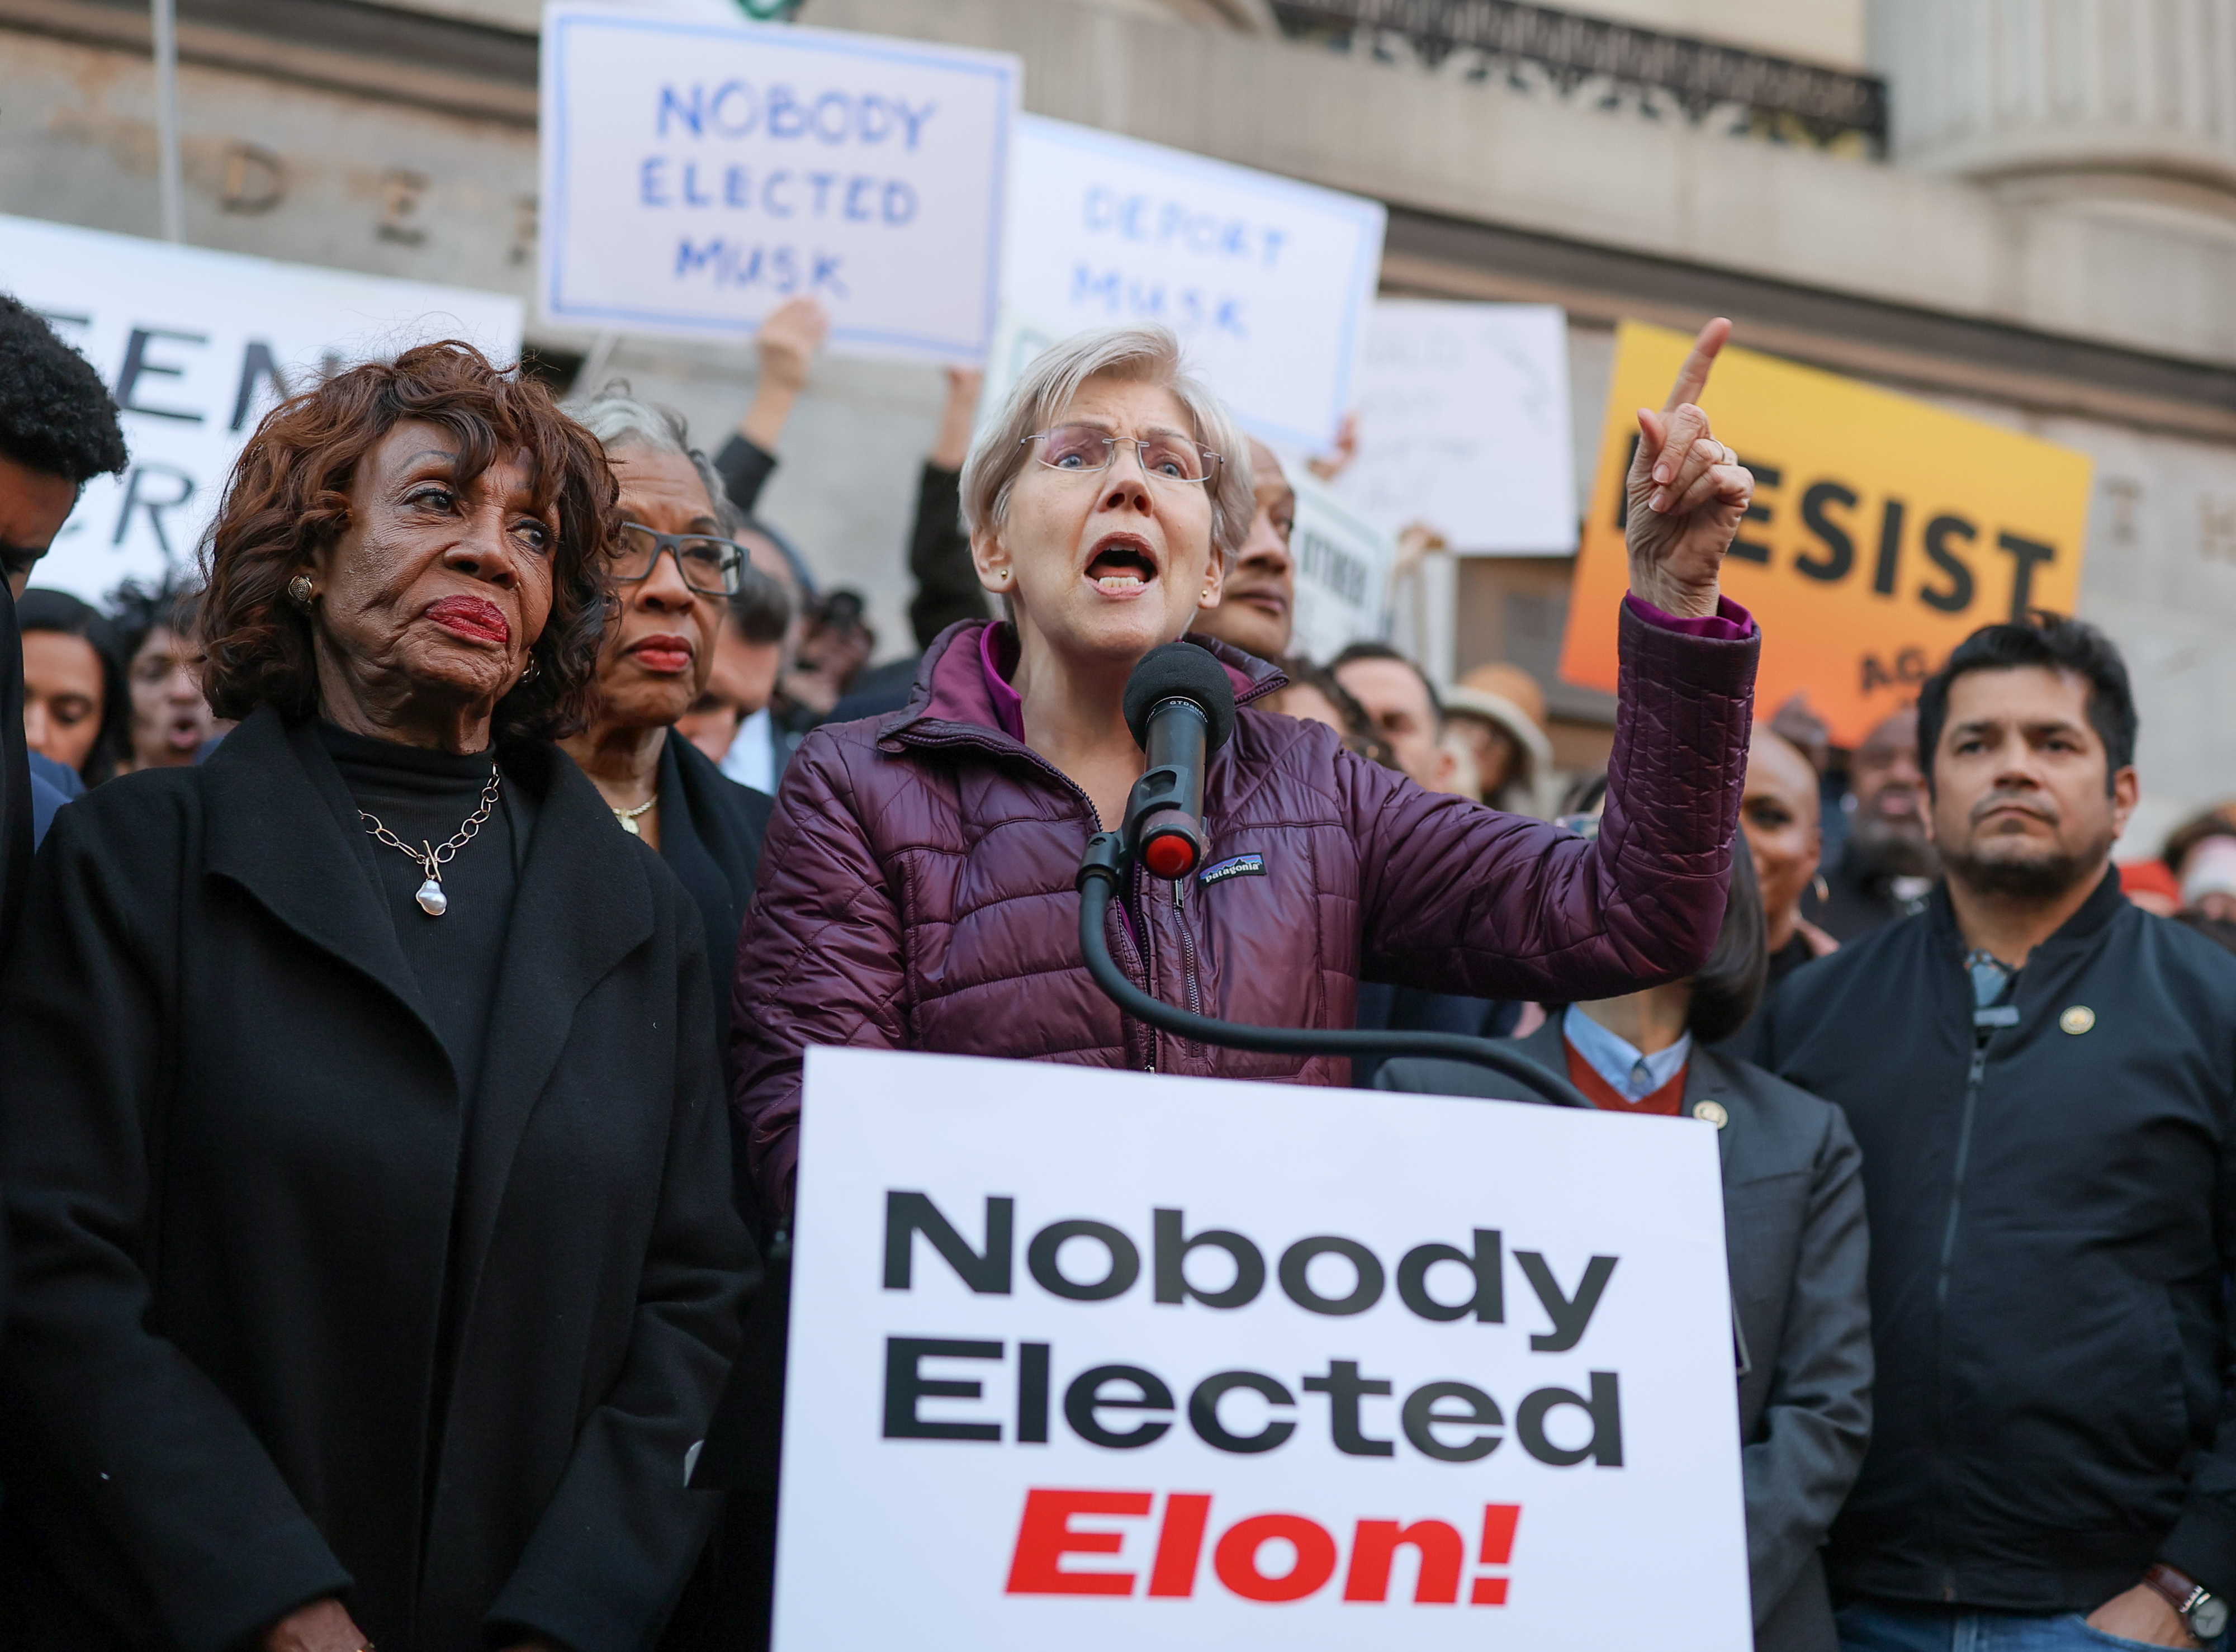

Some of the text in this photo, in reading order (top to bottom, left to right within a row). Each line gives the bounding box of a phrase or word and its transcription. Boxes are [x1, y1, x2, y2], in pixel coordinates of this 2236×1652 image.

[655, 79, 940, 152] NOBODY
[639, 155, 920, 228] ELECTED
[1083, 183, 1287, 269] DEPORT
[675, 235, 852, 302] MUSK
[1070, 258, 1250, 340] MUSK
[1617, 432, 2058, 627] ESIST
[1169, 700, 1208, 723] GTDaudio
[1205, 862, 1259, 883] patagonia
[882, 1190, 1619, 1353] Nobody
[882, 1336, 1624, 1468] Elected
[1005, 1487, 1522, 1607] Elon!
